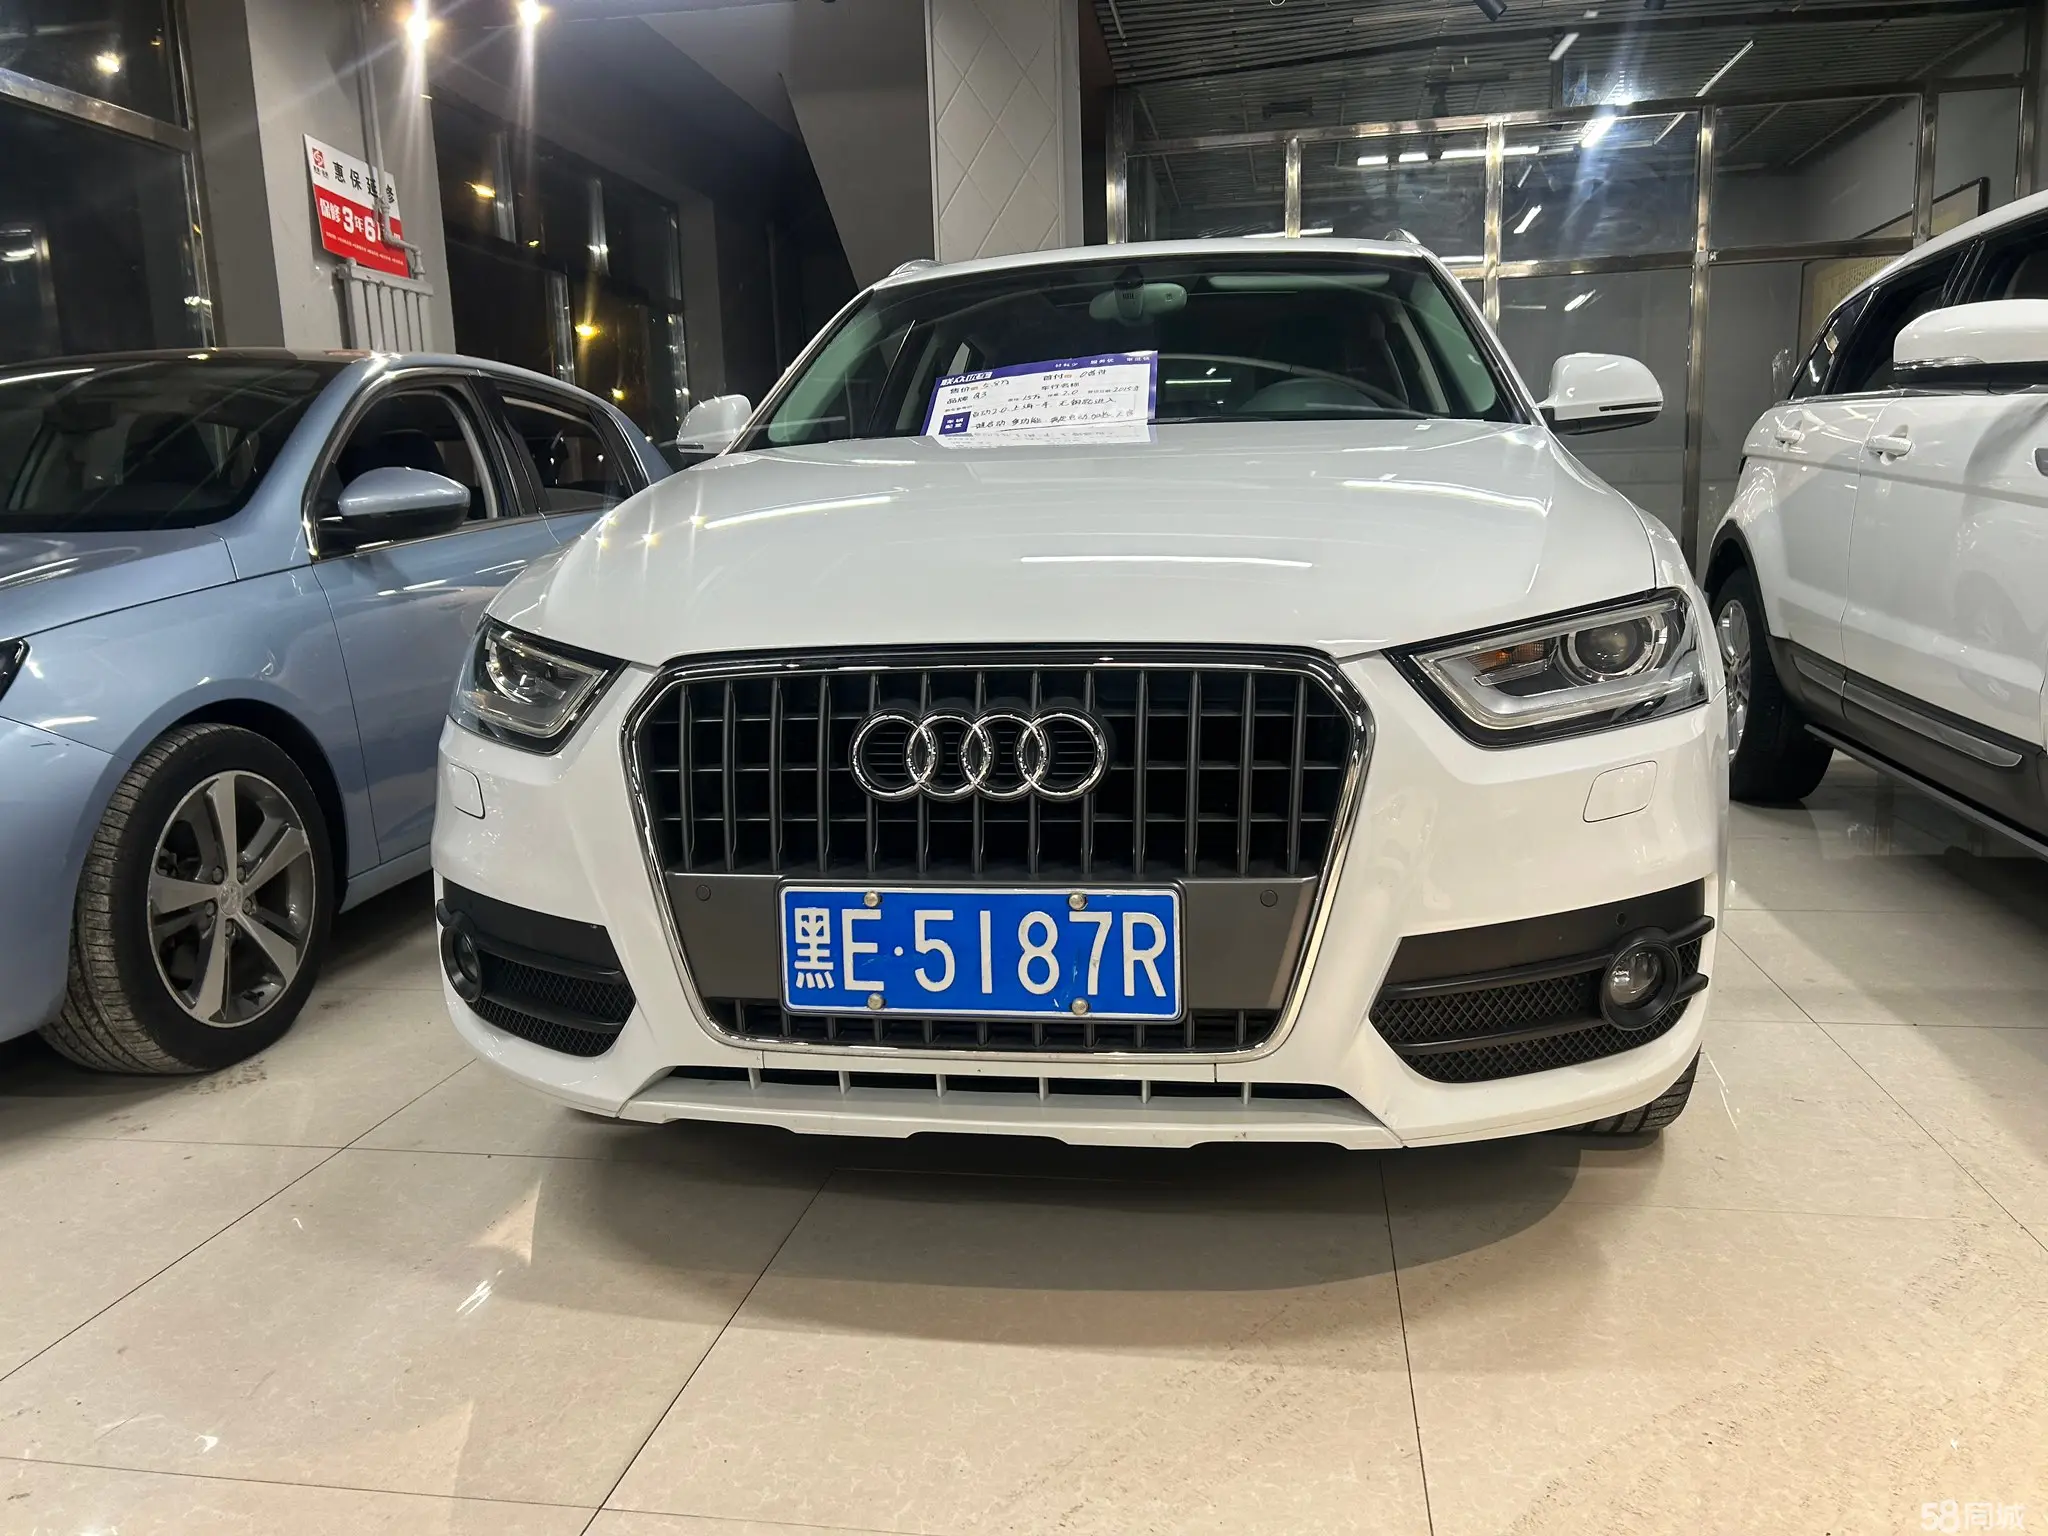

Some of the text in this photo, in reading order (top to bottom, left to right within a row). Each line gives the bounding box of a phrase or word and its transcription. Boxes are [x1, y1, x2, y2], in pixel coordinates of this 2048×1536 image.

[1043, 373, 1063, 381] 首付
[946, 396, 968, 405] 品牌
[794, 907, 1167, 998] 黑E·5187R
